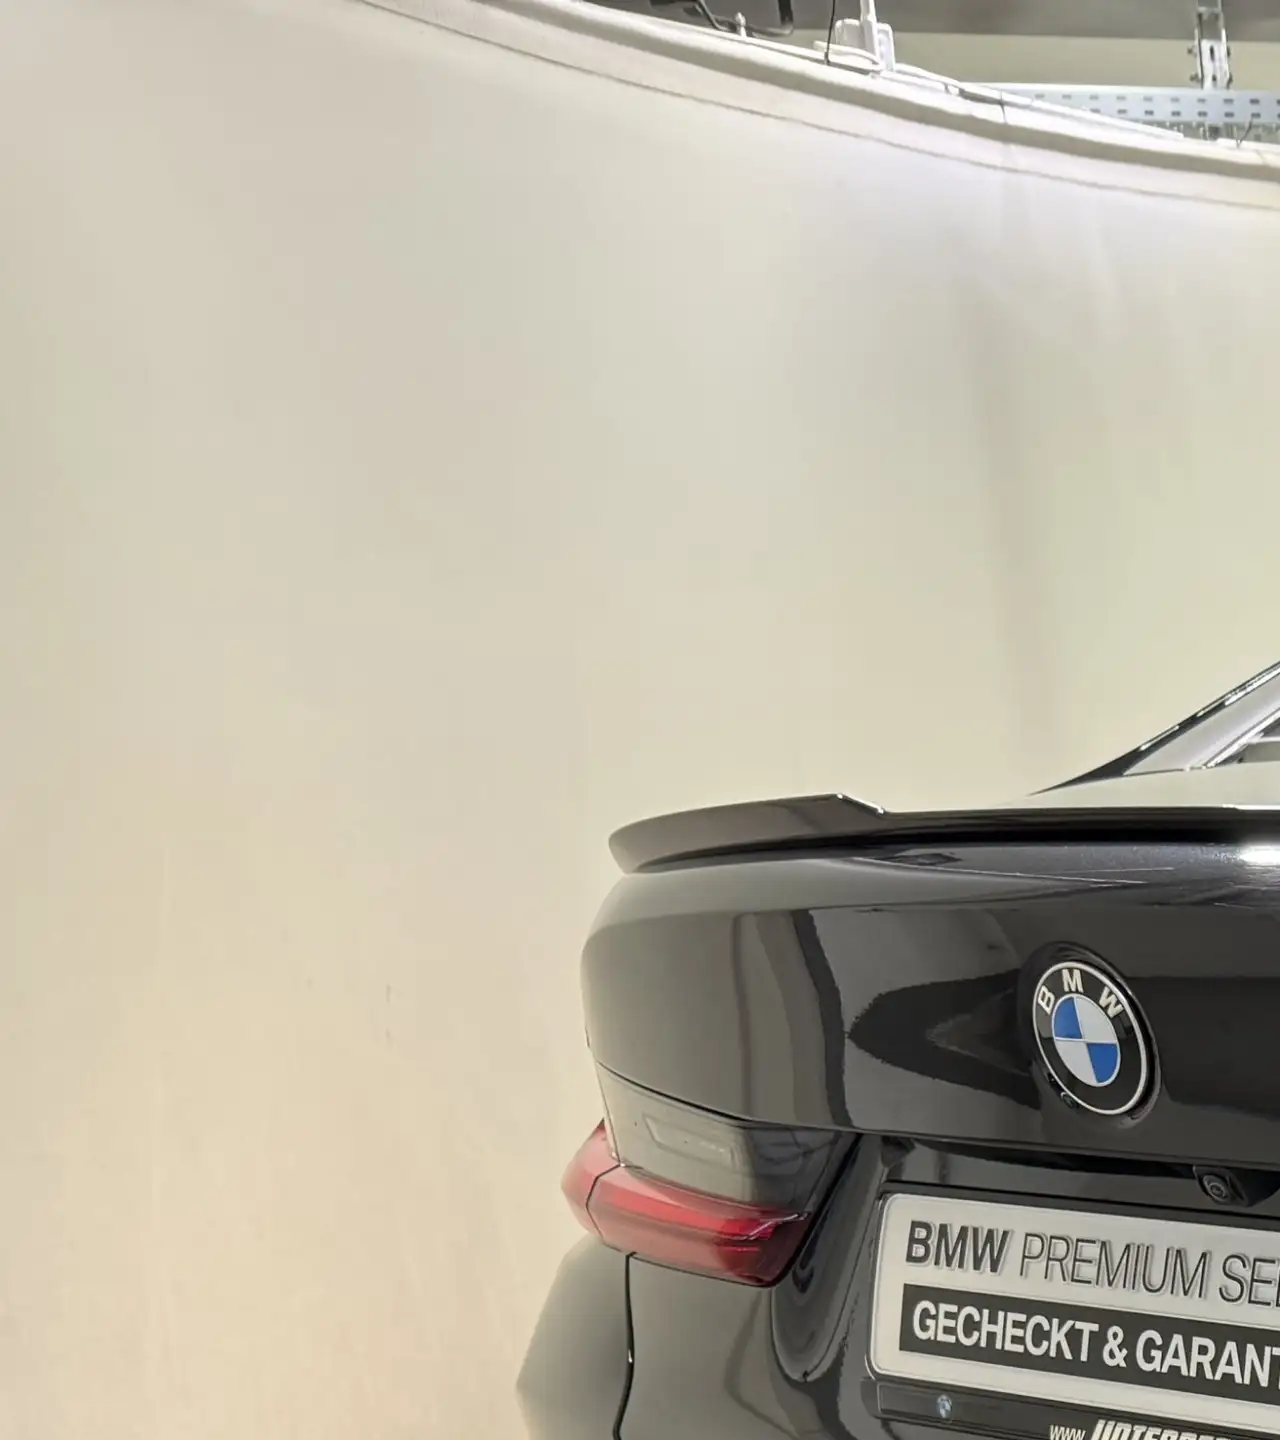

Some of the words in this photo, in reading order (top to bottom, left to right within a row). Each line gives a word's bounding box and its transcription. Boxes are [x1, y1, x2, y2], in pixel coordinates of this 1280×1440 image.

[1037, 968, 1124, 1018] BMW
[904, 1219, 1010, 1273] BMW
[1018, 1232, 1208, 1299] PREMIUM
[911, 1300, 1099, 1364] GECHECKT
[1102, 1325, 1129, 1368] &
